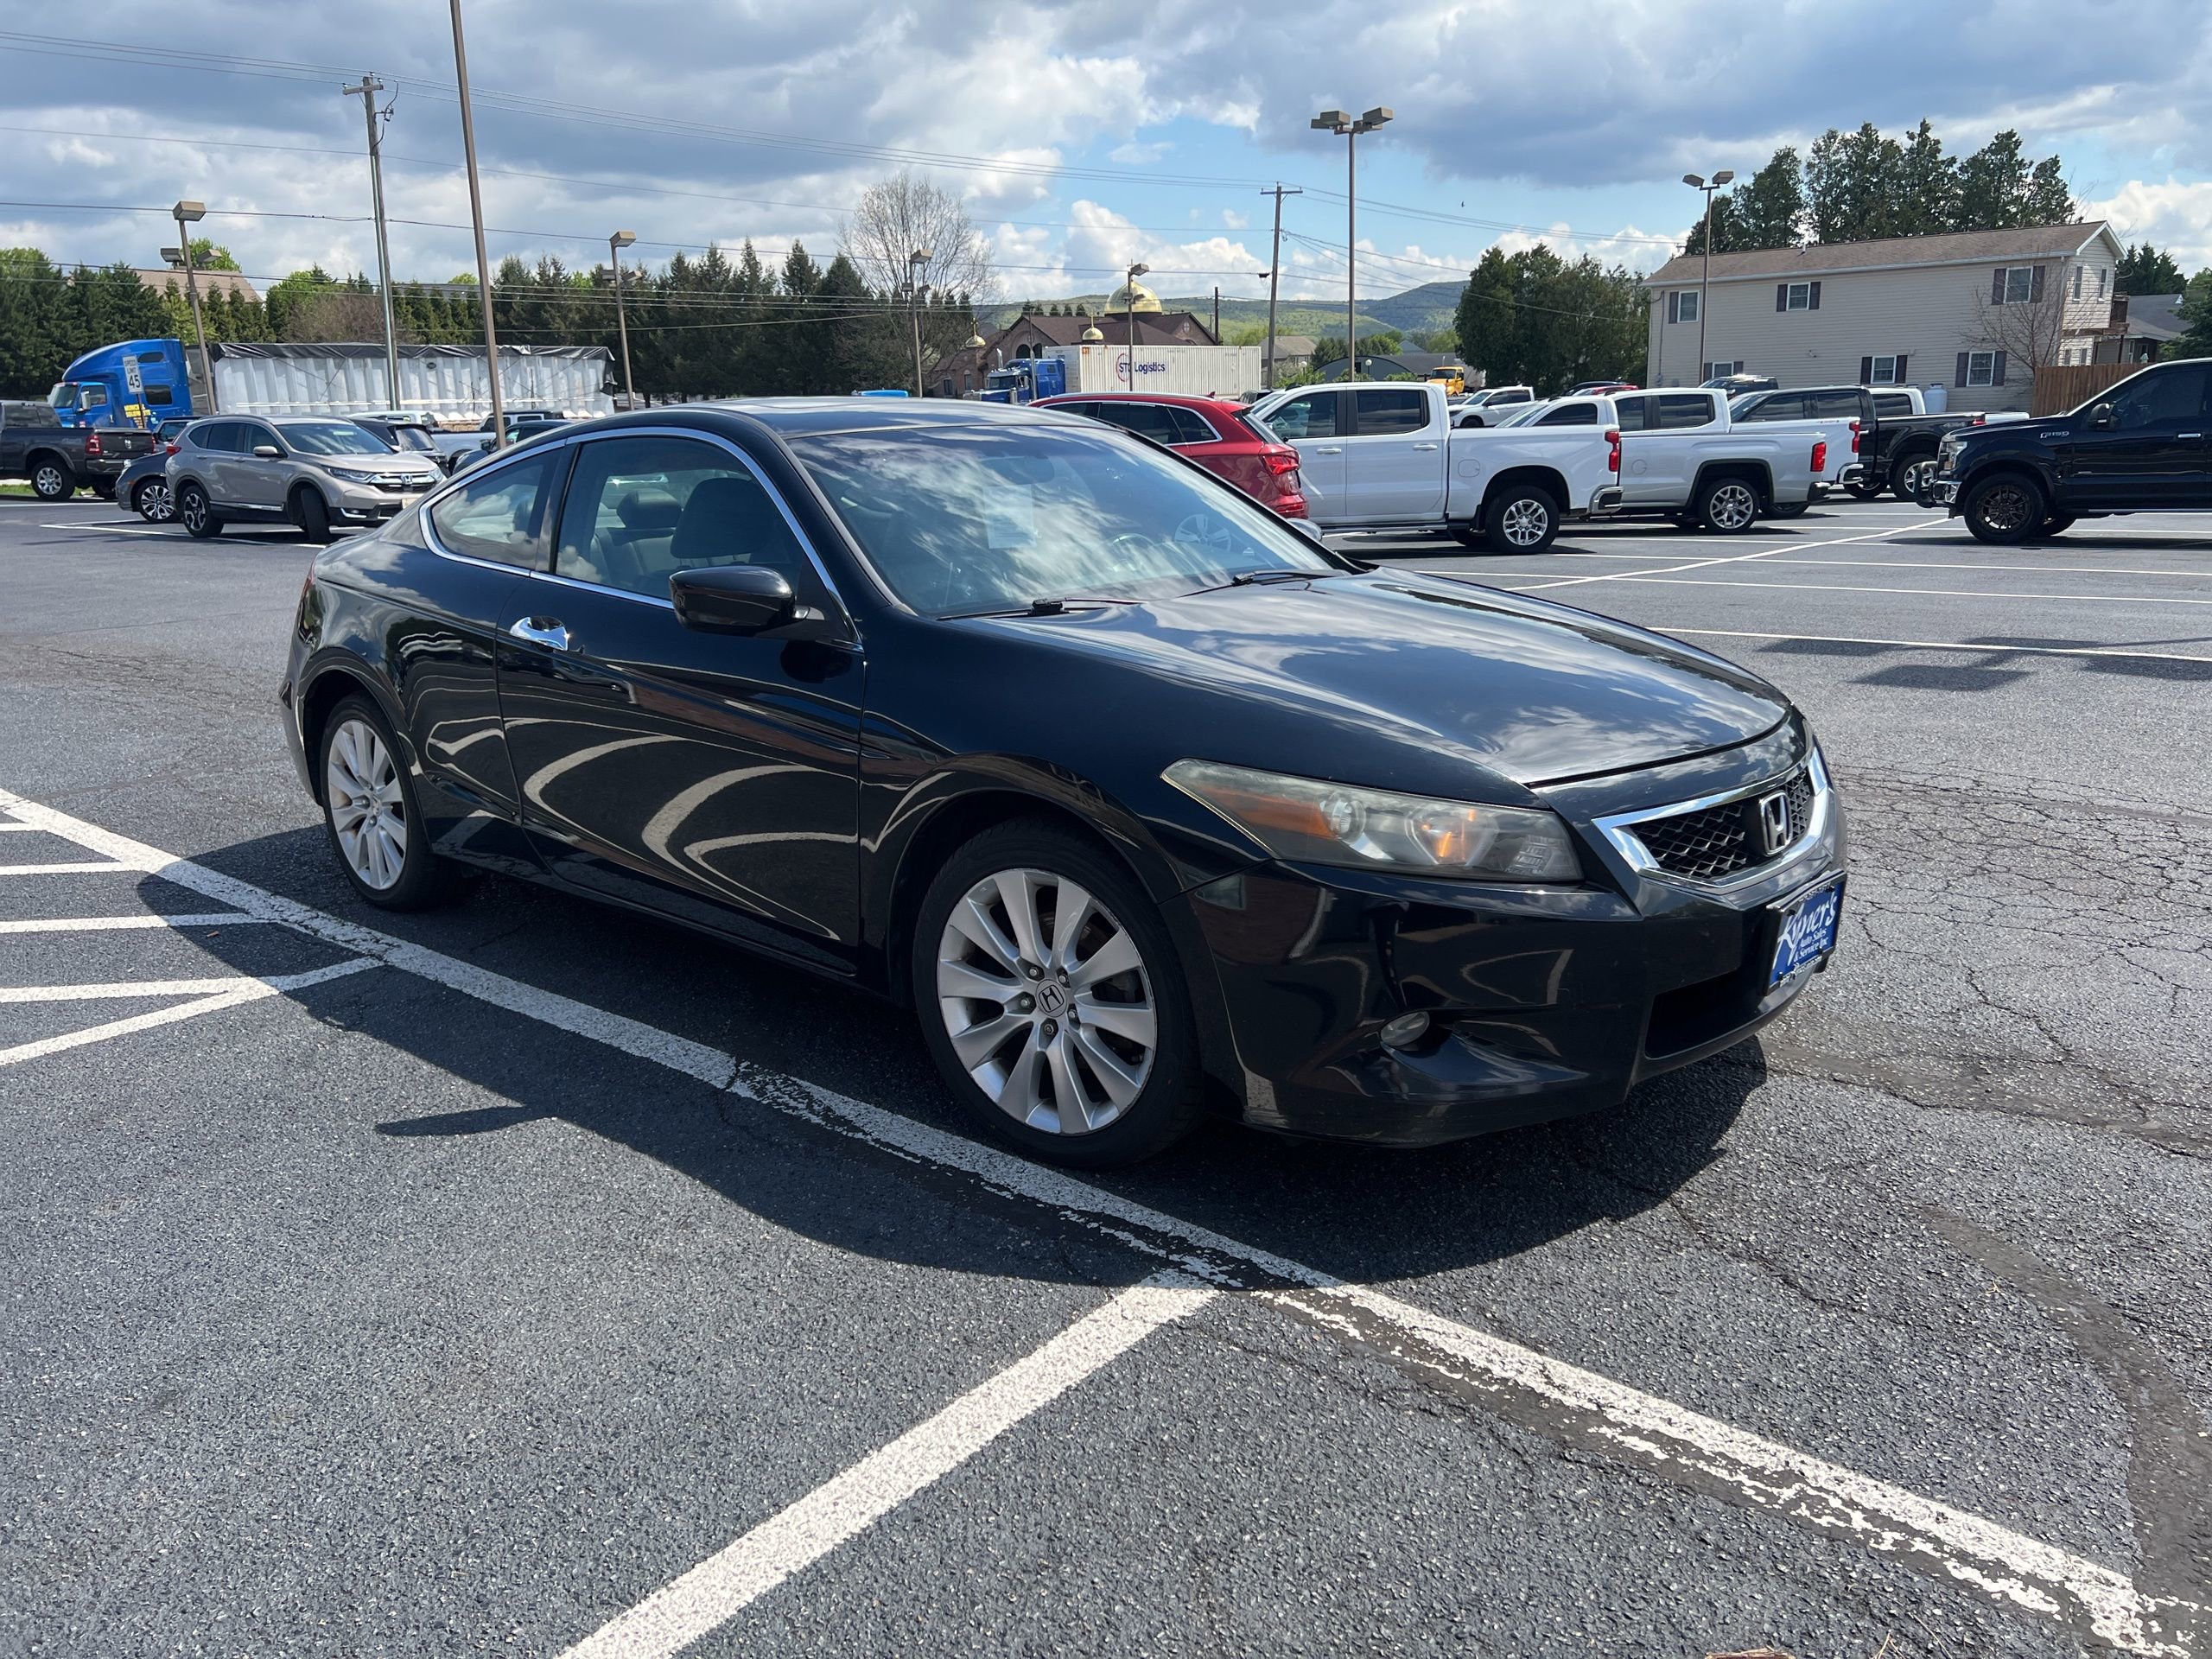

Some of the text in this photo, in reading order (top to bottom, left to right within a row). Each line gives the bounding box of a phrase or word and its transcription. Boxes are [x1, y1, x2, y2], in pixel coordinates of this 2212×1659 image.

[1135, 362, 1166, 374] Logistics
[129, 374, 141, 388] 45
[1800, 928, 1827, 947] Auto Sales
[1798, 942, 1820, 959] Service
